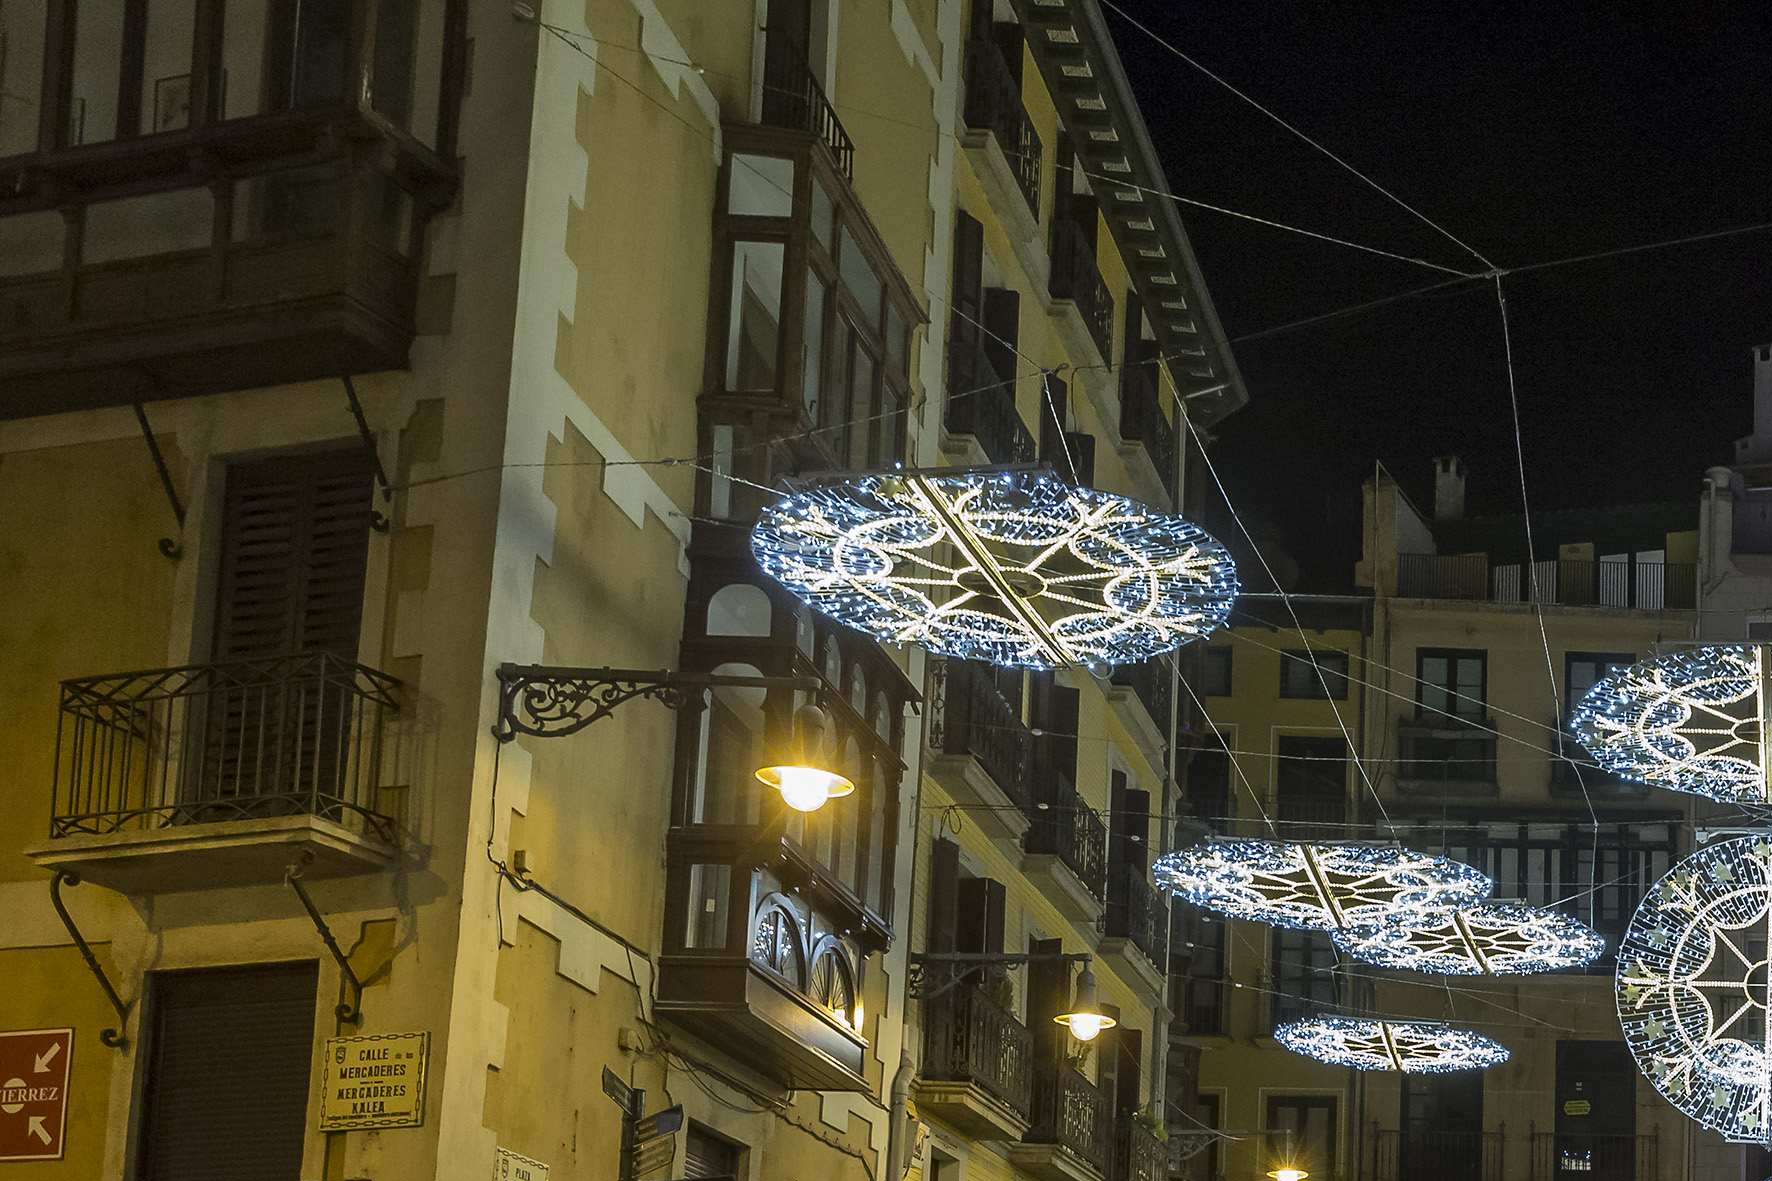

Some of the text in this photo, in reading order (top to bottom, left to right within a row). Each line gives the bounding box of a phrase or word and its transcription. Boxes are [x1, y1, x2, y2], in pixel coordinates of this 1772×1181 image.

[359, 1048, 389, 1061] CALLE
[339, 1064, 406, 1080] MERCADERES
[337, 1085, 406, 1100] MERCADERES
[352, 1101, 385, 1114] KALEA
[515, 1167, 531, 1181] PLAZA
